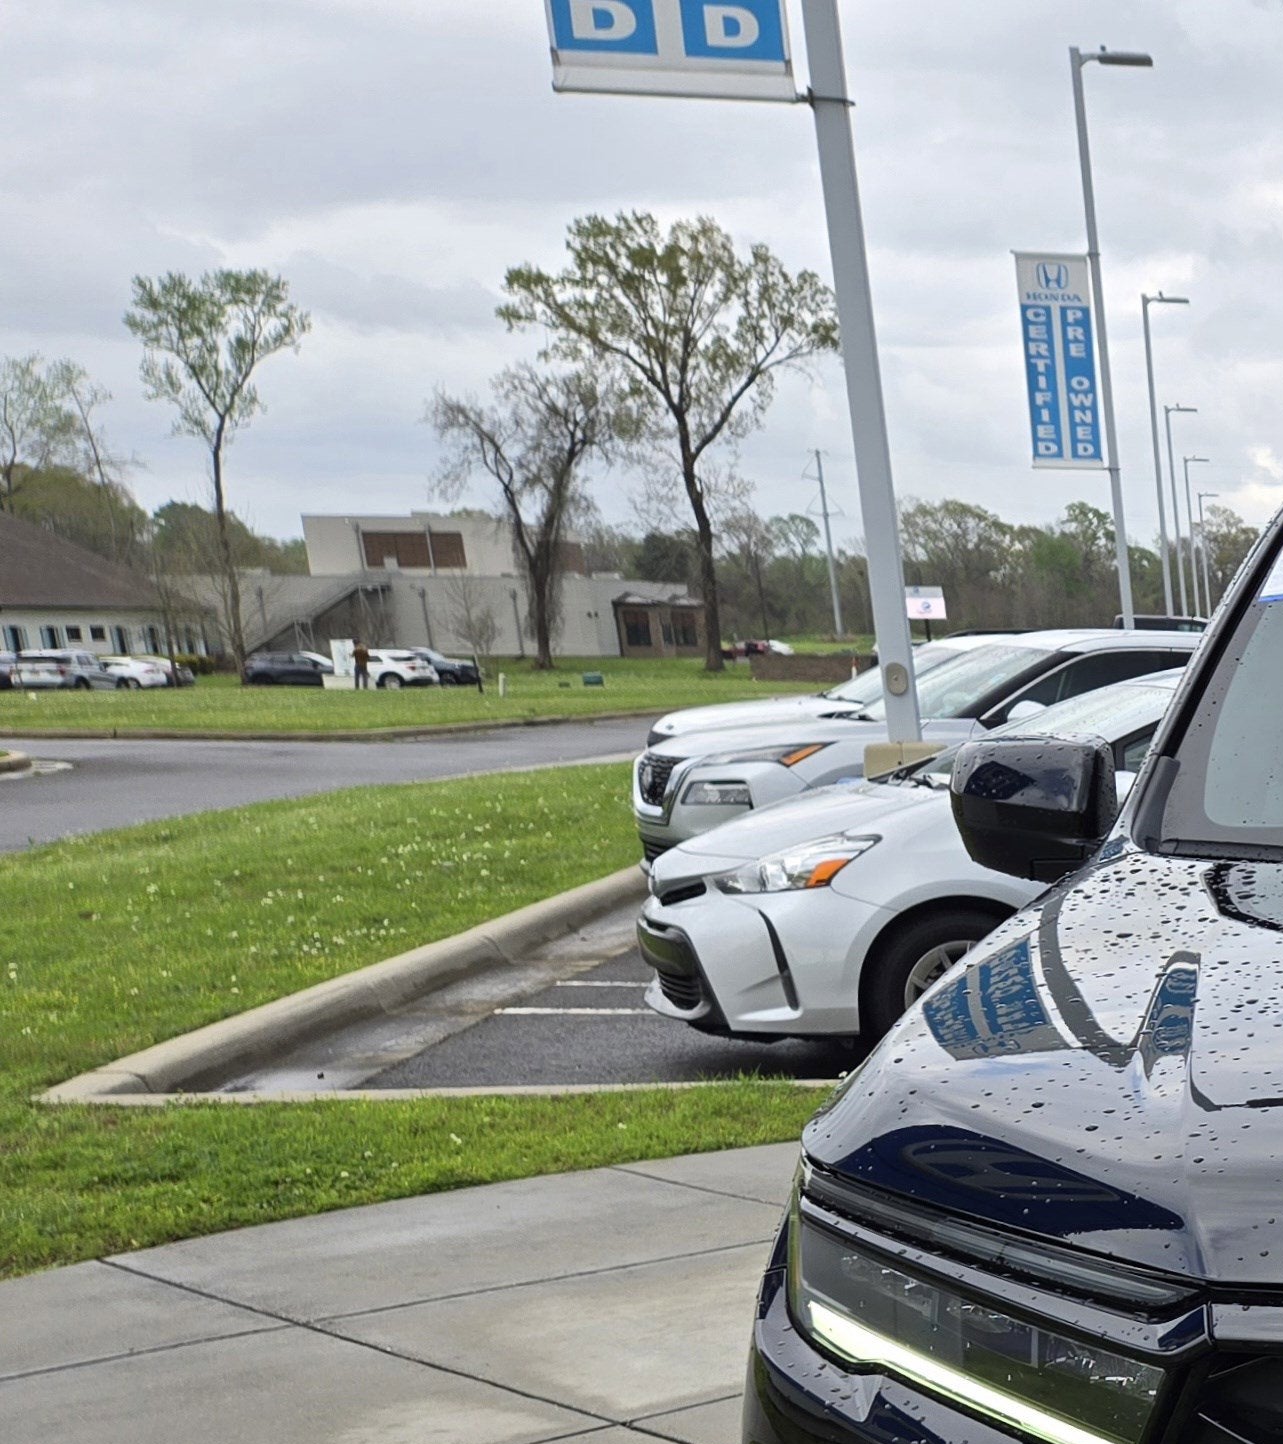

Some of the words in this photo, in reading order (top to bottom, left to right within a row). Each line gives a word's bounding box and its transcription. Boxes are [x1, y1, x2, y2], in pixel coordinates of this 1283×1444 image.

[1026, 292, 1082, 303] HONDA
[1066, 309, 1086, 358] PRE
[1025, 308, 1058, 456] CERTIFIED
[1069, 376, 1094, 456] OWNED
